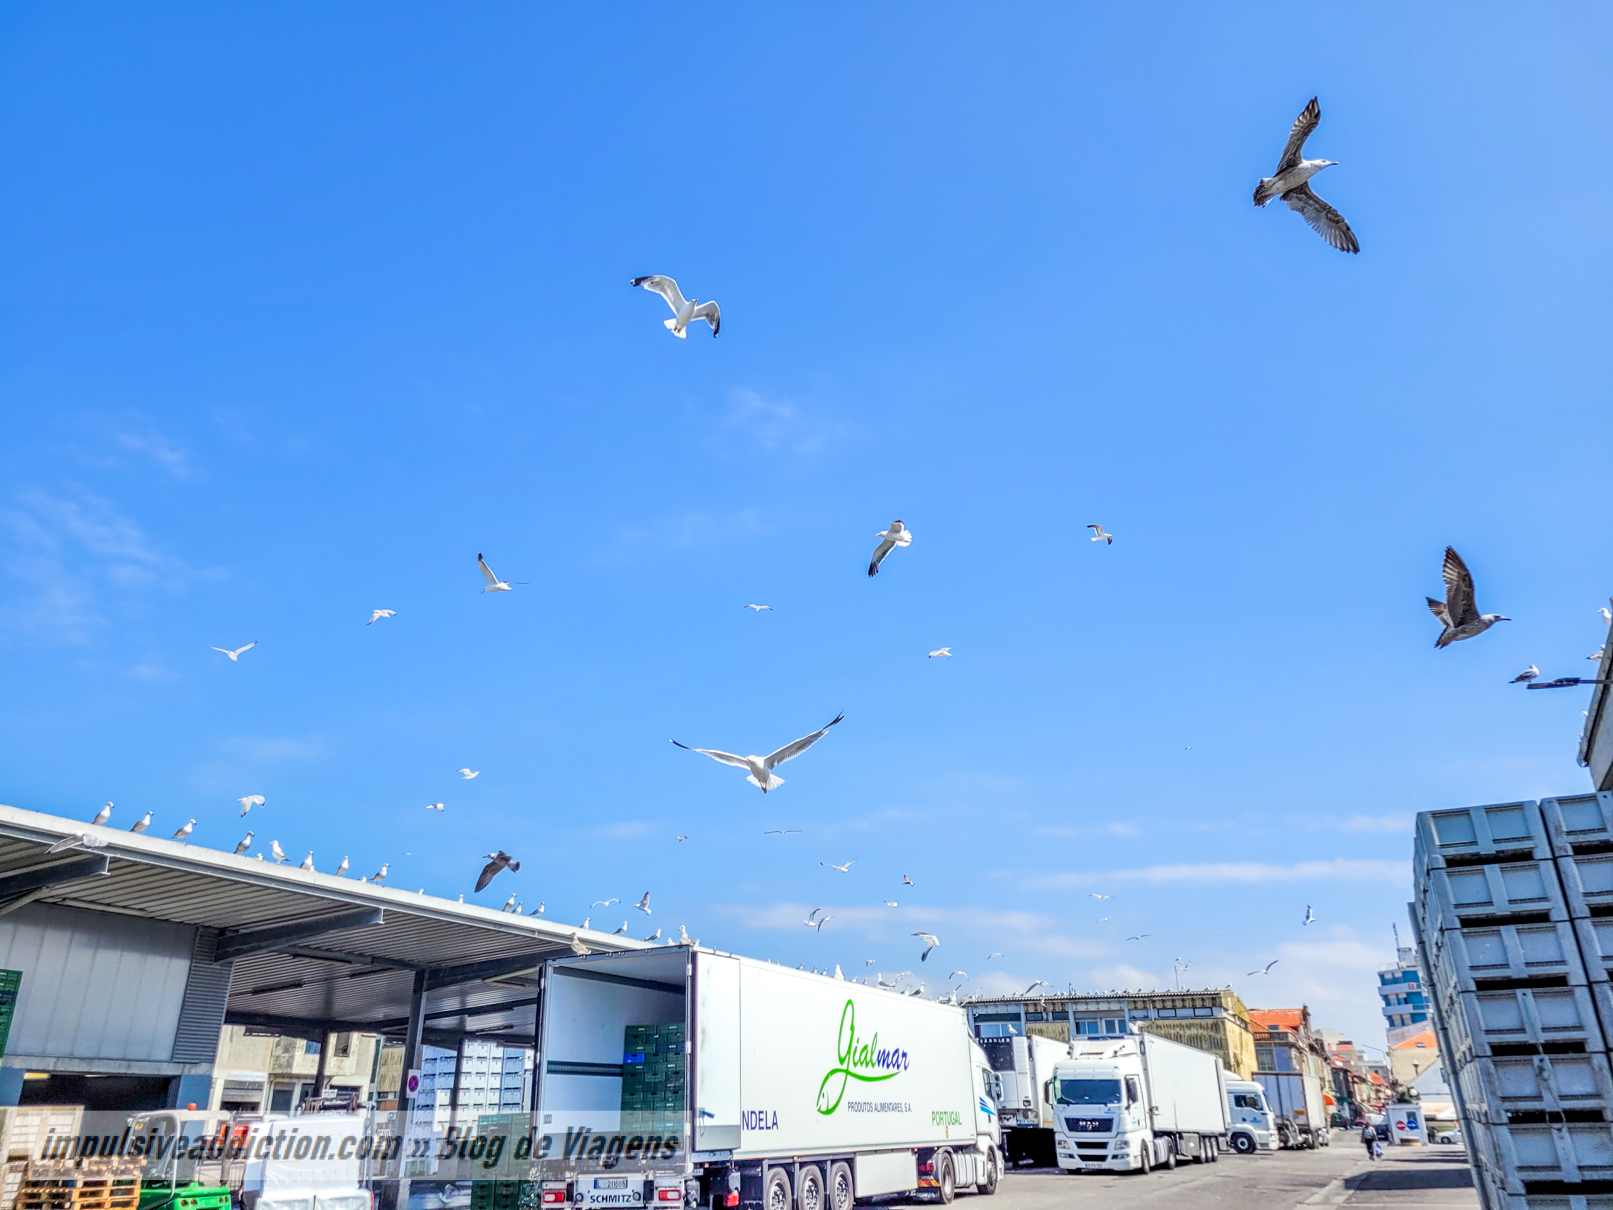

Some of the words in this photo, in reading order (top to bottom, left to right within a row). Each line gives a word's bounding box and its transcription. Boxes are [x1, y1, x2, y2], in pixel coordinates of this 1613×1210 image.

[847, 1101, 873, 1113] PRODUTOS
[742, 1110, 779, 1131] NDELA
[932, 1111, 962, 1126] PORTUGAL
[590, 1194, 632, 1204] SCHMITZ
